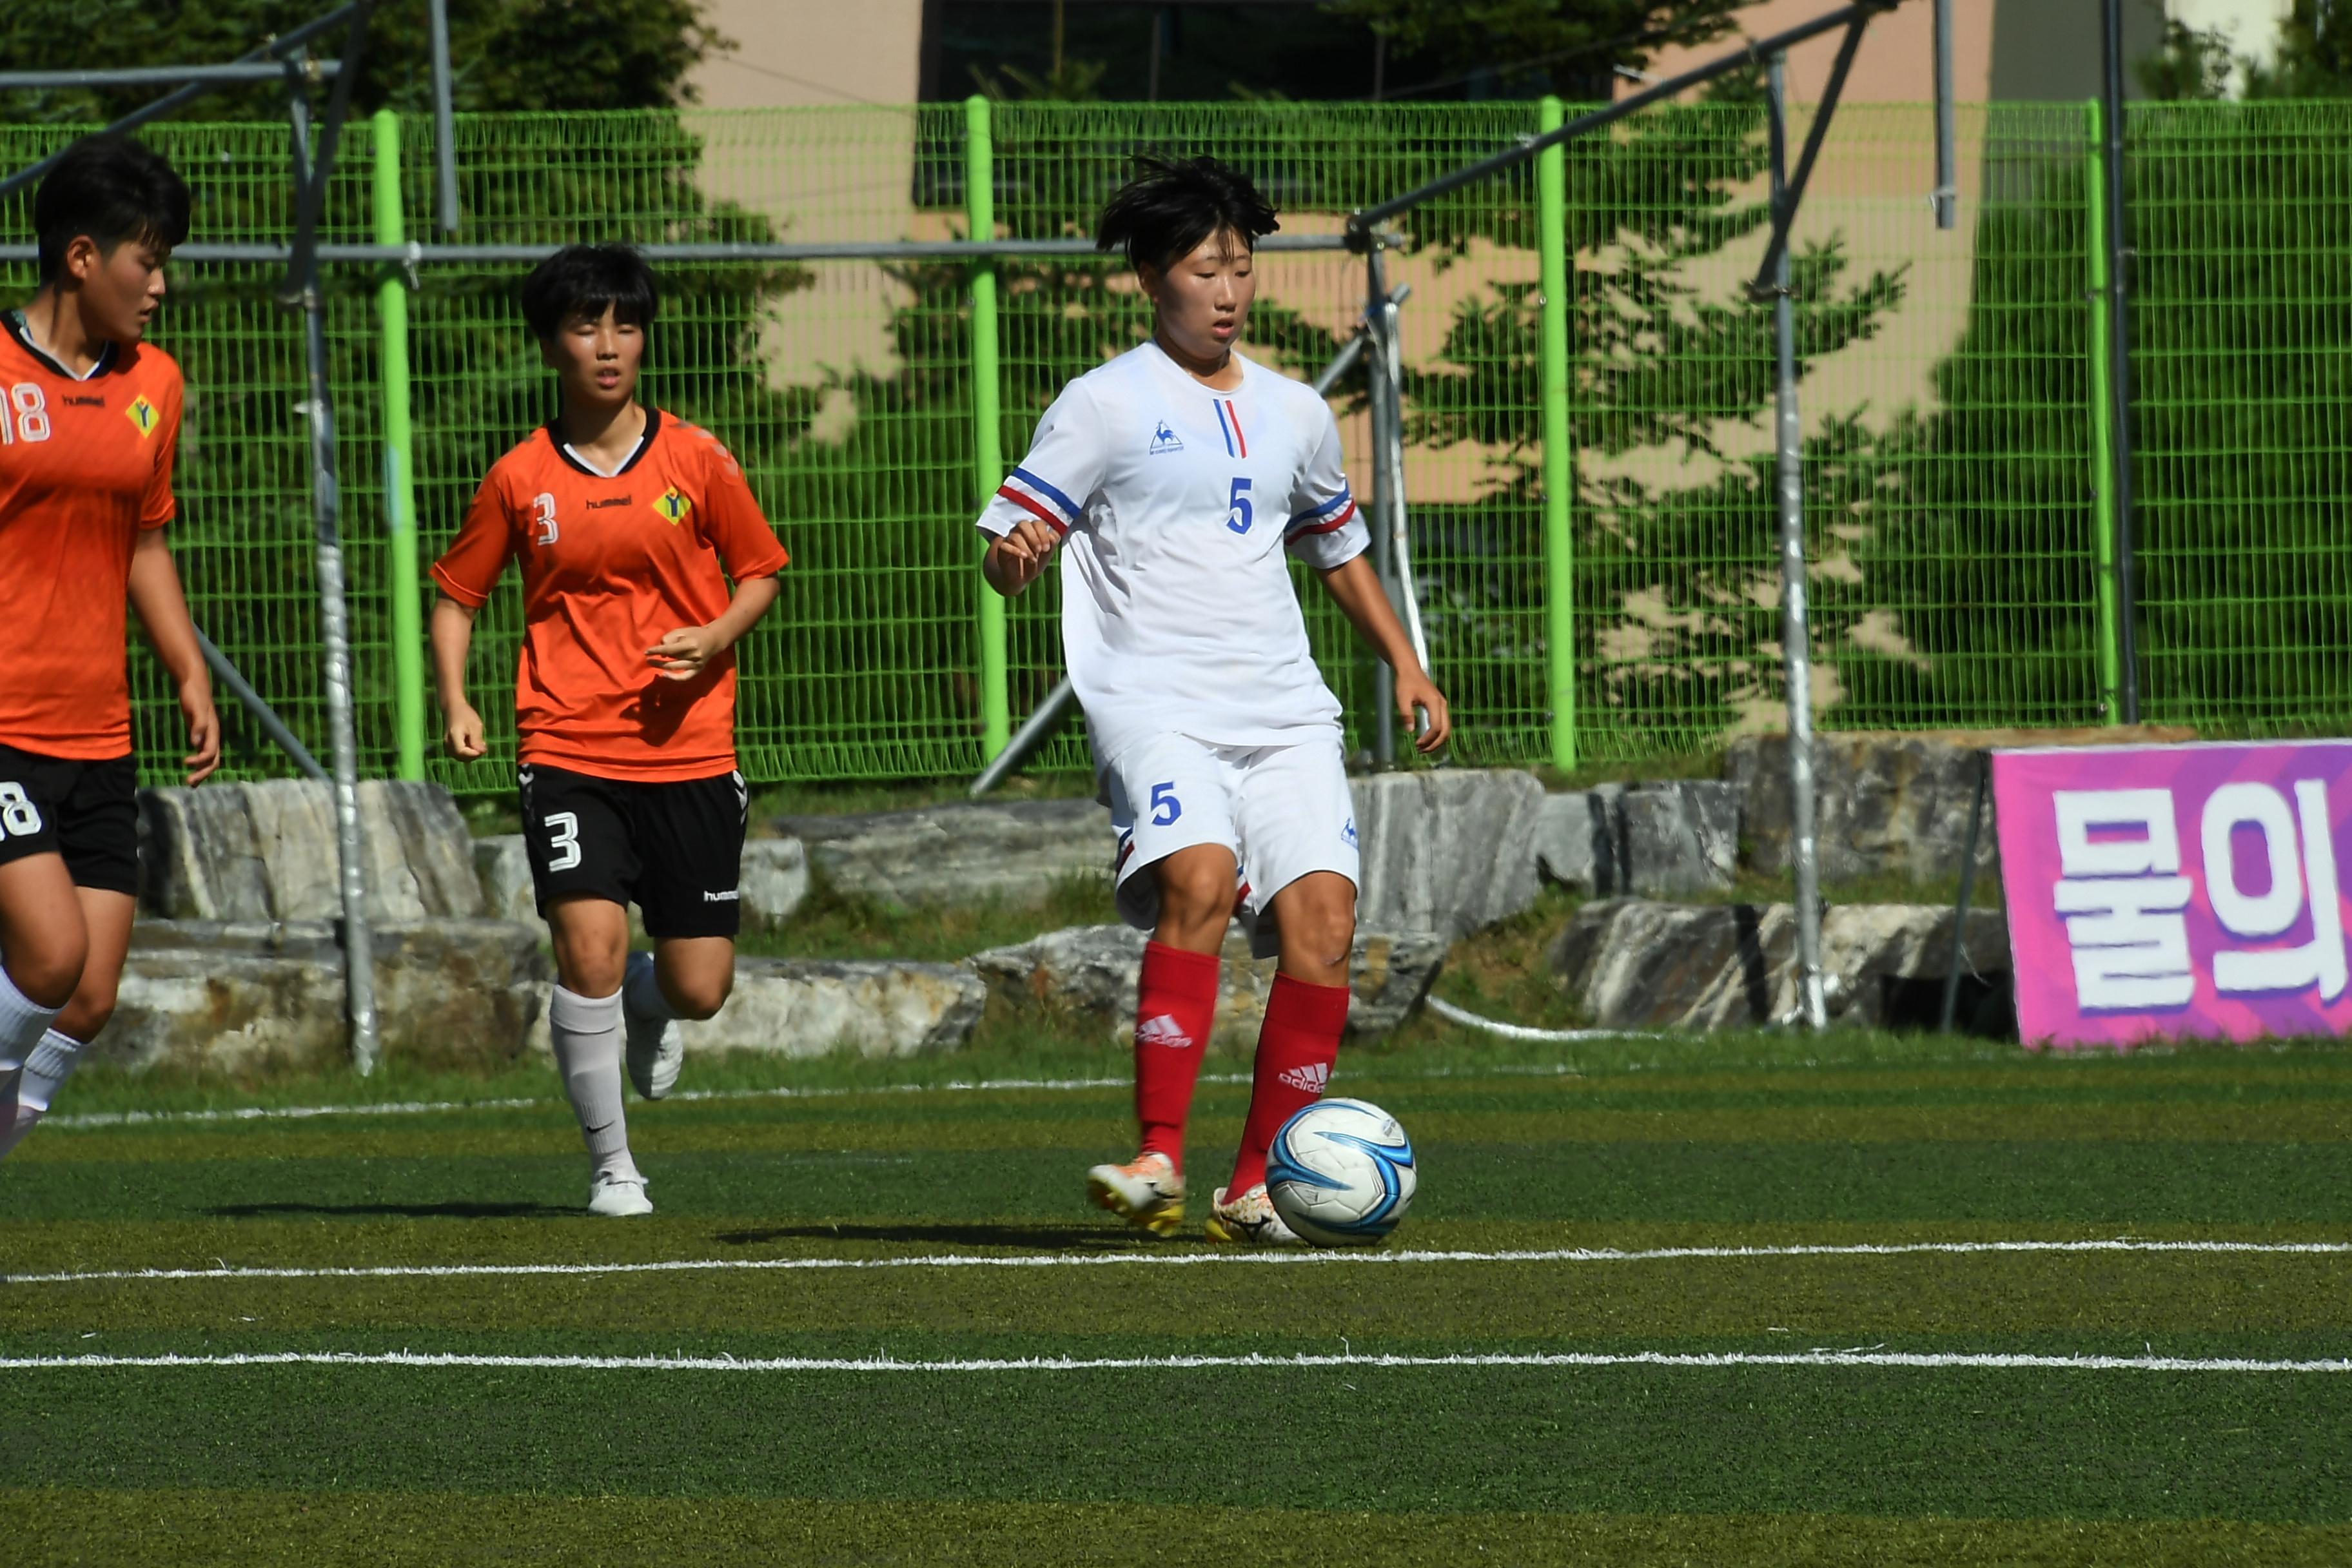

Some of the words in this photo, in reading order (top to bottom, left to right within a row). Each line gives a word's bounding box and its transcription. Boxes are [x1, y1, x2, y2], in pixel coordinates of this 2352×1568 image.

[0, 382, 50, 446] 18
[533, 492, 559, 546] 3
[1226, 477, 1253, 535] 5
[0, 781, 42, 842] 8
[1150, 781, 1182, 827] 5
[544, 810, 582, 872] 3
[2053, 778, 2348, 1010] 물의
[1278, 1072, 1326, 1094] adida
